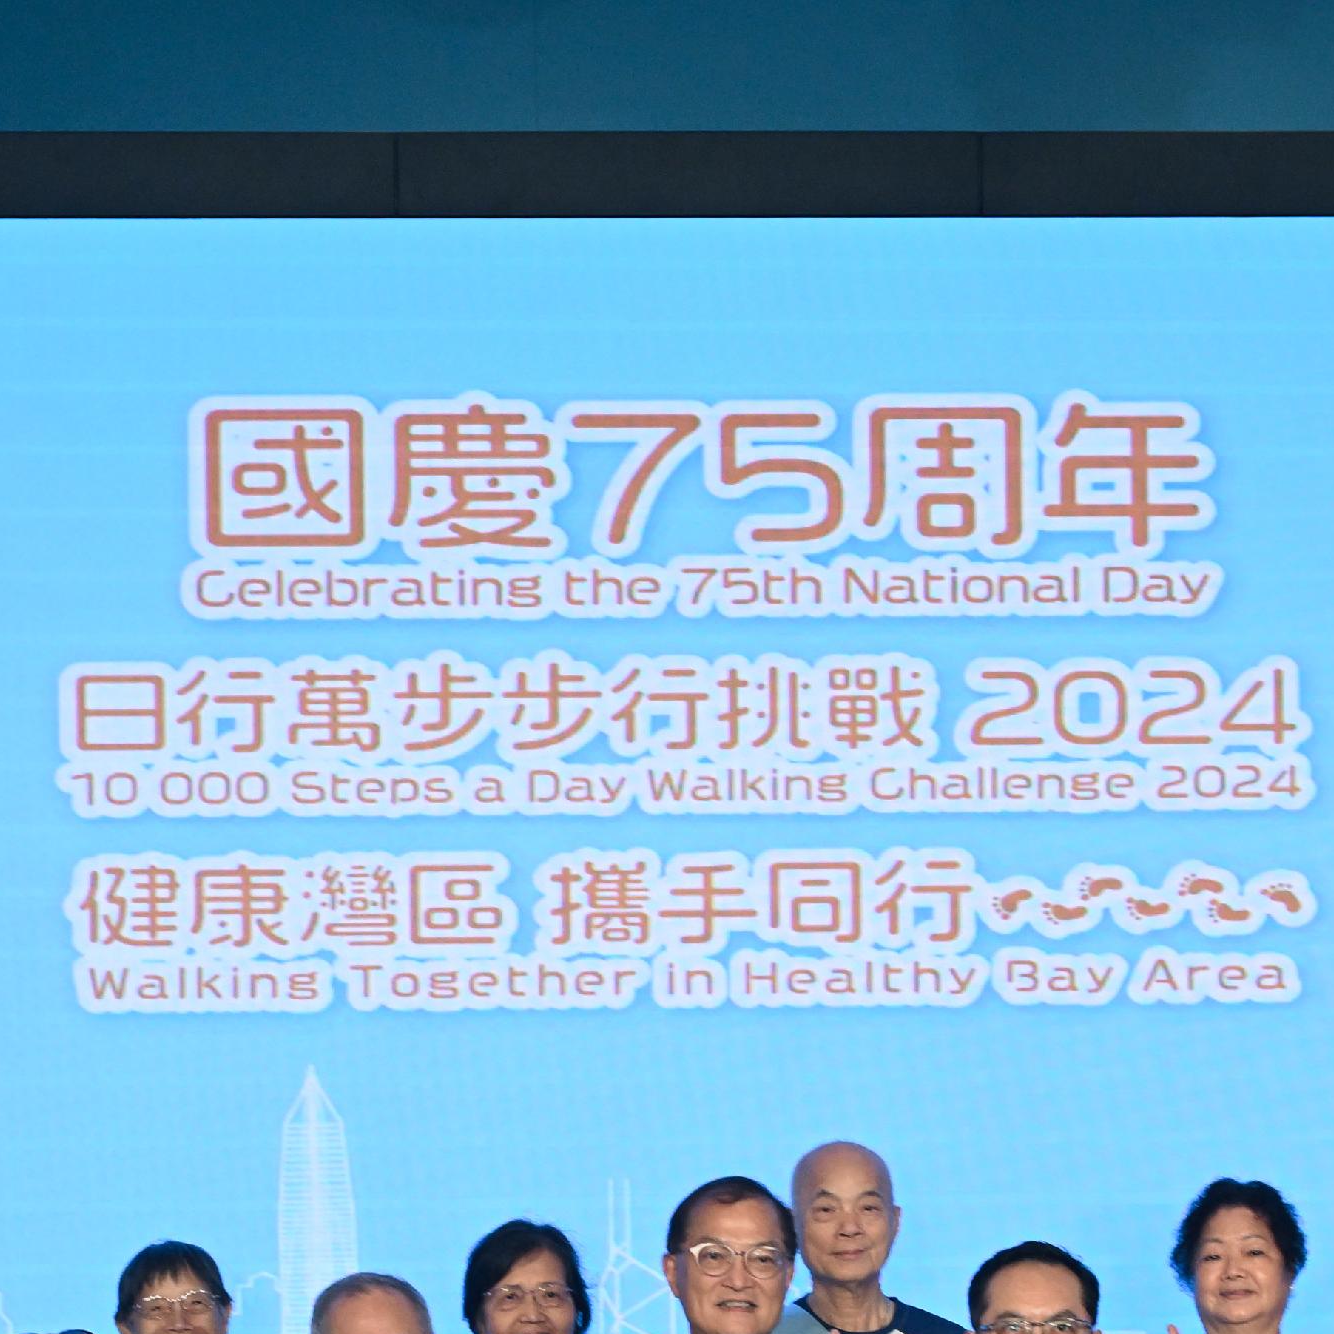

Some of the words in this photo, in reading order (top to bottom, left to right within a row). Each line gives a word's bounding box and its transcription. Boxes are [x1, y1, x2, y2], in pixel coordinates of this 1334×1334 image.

[205, 402, 1201, 550] 國慶75周年
[195, 568, 543, 611] Celebrating
[563, 568, 661, 608] the
[682, 567, 823, 606] 75th
[843, 565, 1081, 606] National
[1104, 564, 1212, 609] Day
[75, 662, 926, 755] 日行萬步步行挑戰
[969, 668, 1298, 748] 2024
[70, 770, 141, 807] 10
[157, 769, 270, 807] 000
[290, 768, 455, 806] Steps
[474, 777, 507, 805] a
[525, 769, 628, 808] Day
[647, 766, 848, 806] Walking
[870, 765, 1136, 804] Challenge
[1156, 762, 1303, 800] 2024
[79, 862, 505, 950] 健康灣區
[548, 857, 975, 948] 攜手同行
[89, 964, 320, 1003] Walking
[348, 962, 637, 1002] Together
[665, 960, 714, 998] in
[743, 959, 979, 1000] Healthy
[1005, 959, 1111, 996] Bay
[1141, 957, 1287, 994] Area
